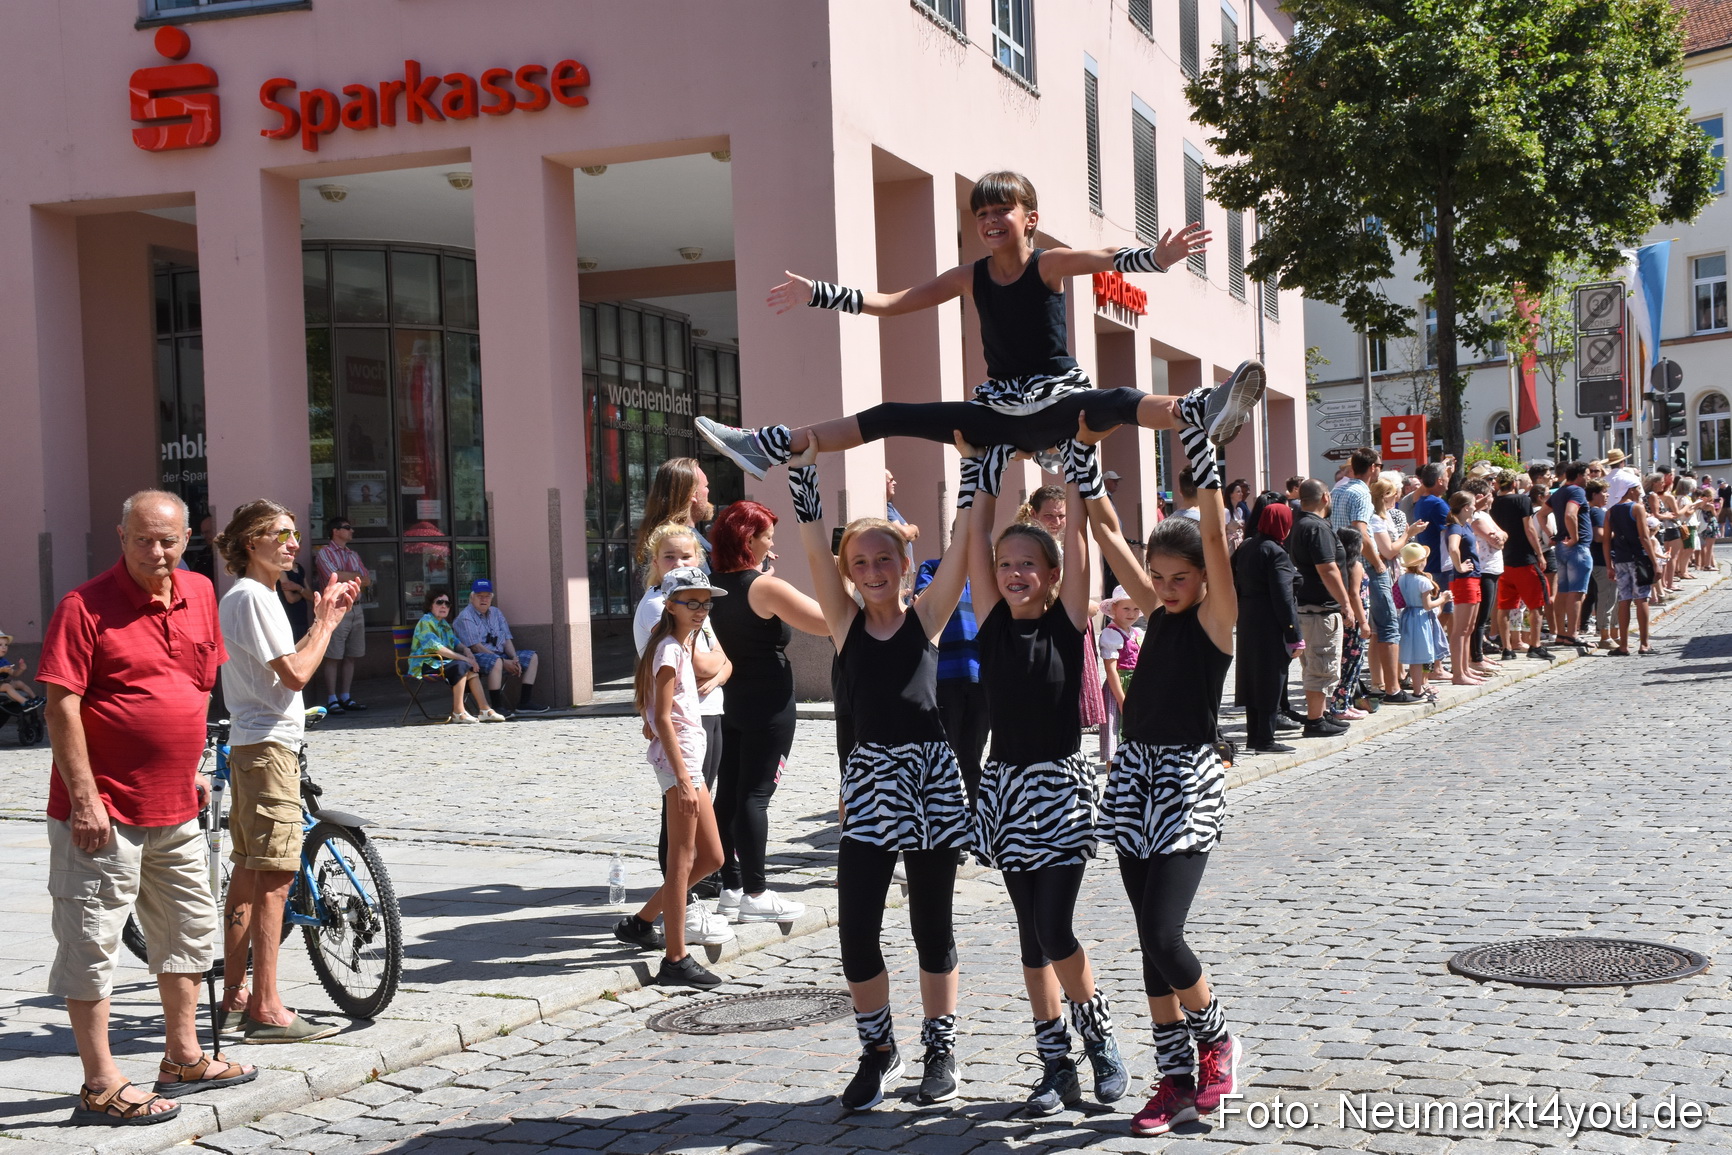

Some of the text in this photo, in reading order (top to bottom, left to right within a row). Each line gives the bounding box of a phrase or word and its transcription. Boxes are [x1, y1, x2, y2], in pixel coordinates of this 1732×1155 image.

[260, 58, 591, 151] Sparkasse
[1590, 319, 1611, 328] ZONE
[1590, 366, 1612, 375] ZONE
[608, 382, 693, 416] wochenblatt
[663, 423, 693, 438] Sparkasse
[1341, 433, 1360, 443] AOK
[162, 472, 179, 483] der
